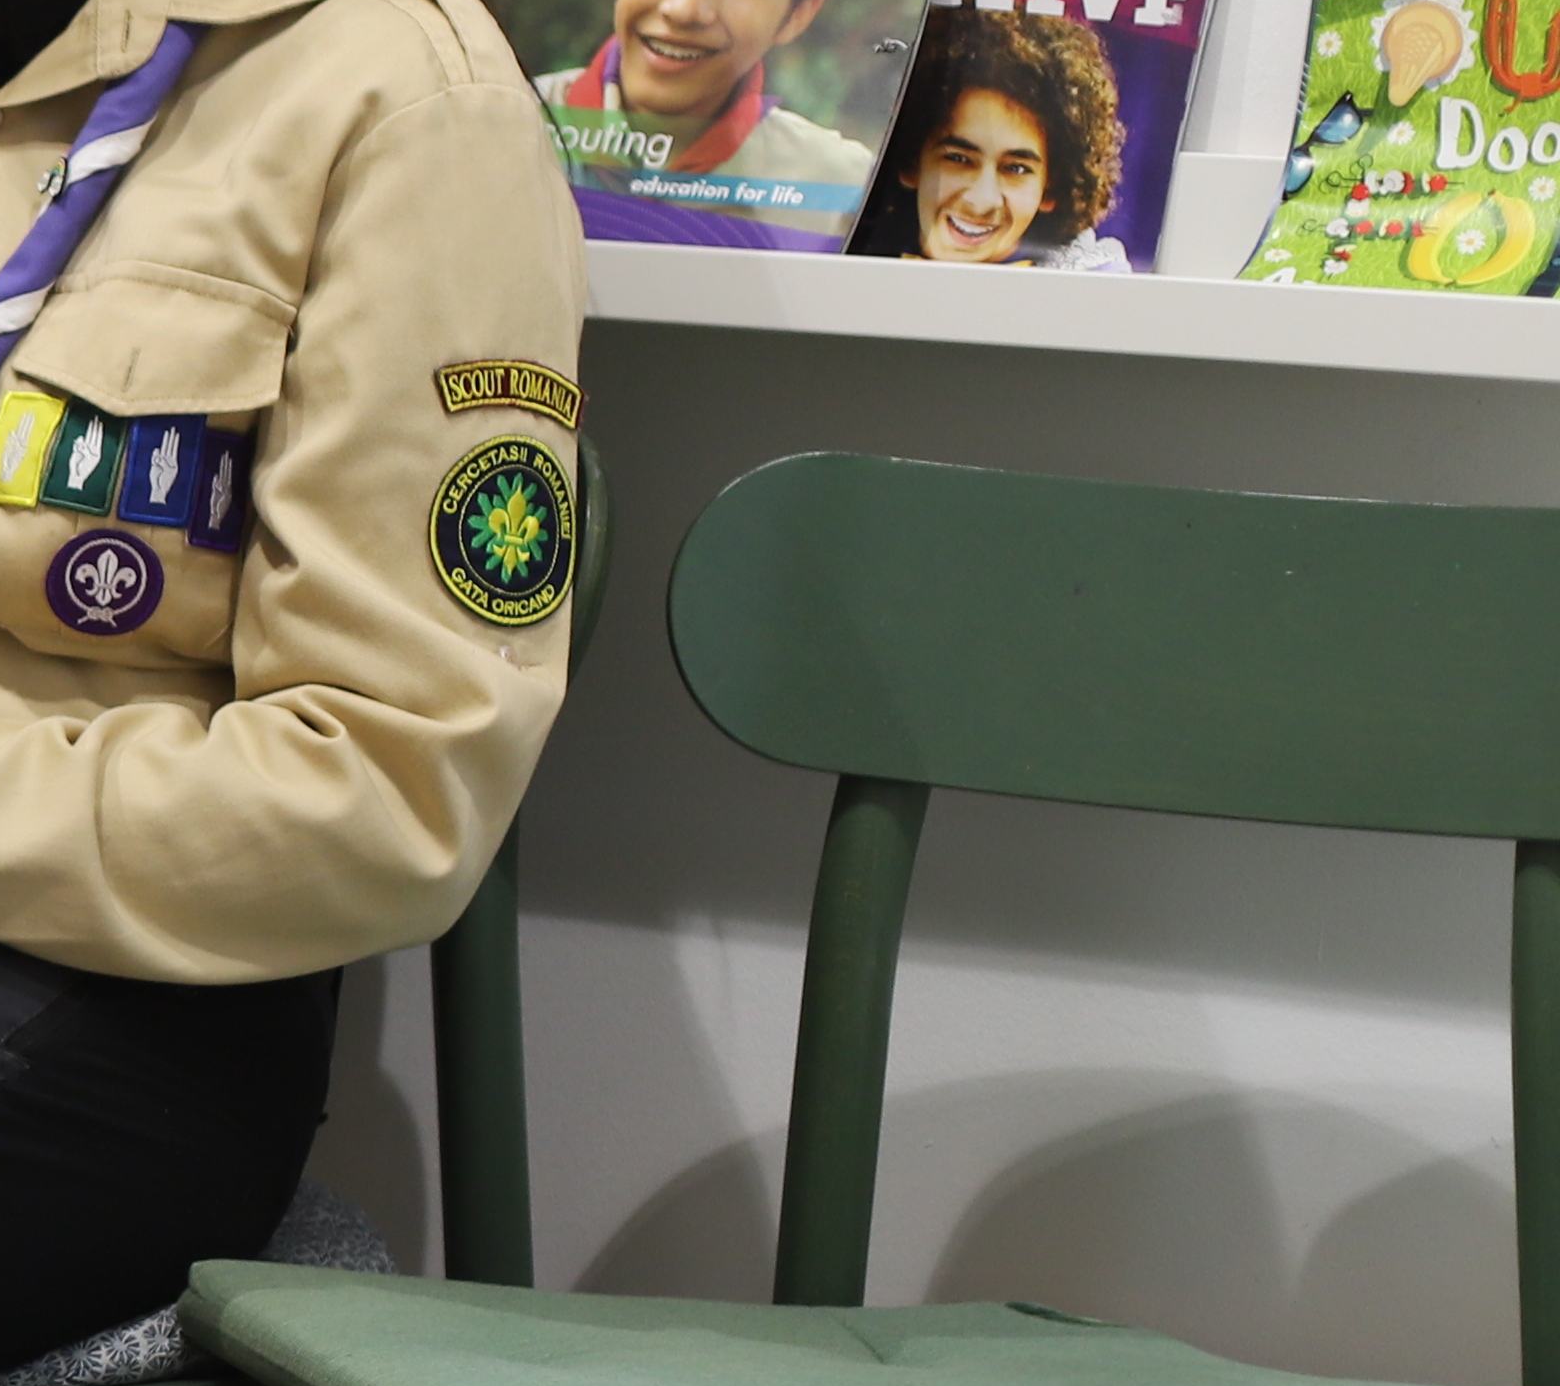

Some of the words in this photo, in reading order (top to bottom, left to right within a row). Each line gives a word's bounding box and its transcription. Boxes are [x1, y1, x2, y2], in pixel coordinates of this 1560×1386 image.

[630, 175, 729, 201] education
[735, 181, 765, 204] for
[770, 185, 805, 206] life
[448, 367, 505, 402] SCOUT
[509, 367, 573, 418] ROMANIA
[533, 453, 572, 540] ROMANIEI
[451, 566, 488, 609] GATA
[491, 583, 556, 616] ORICAND
